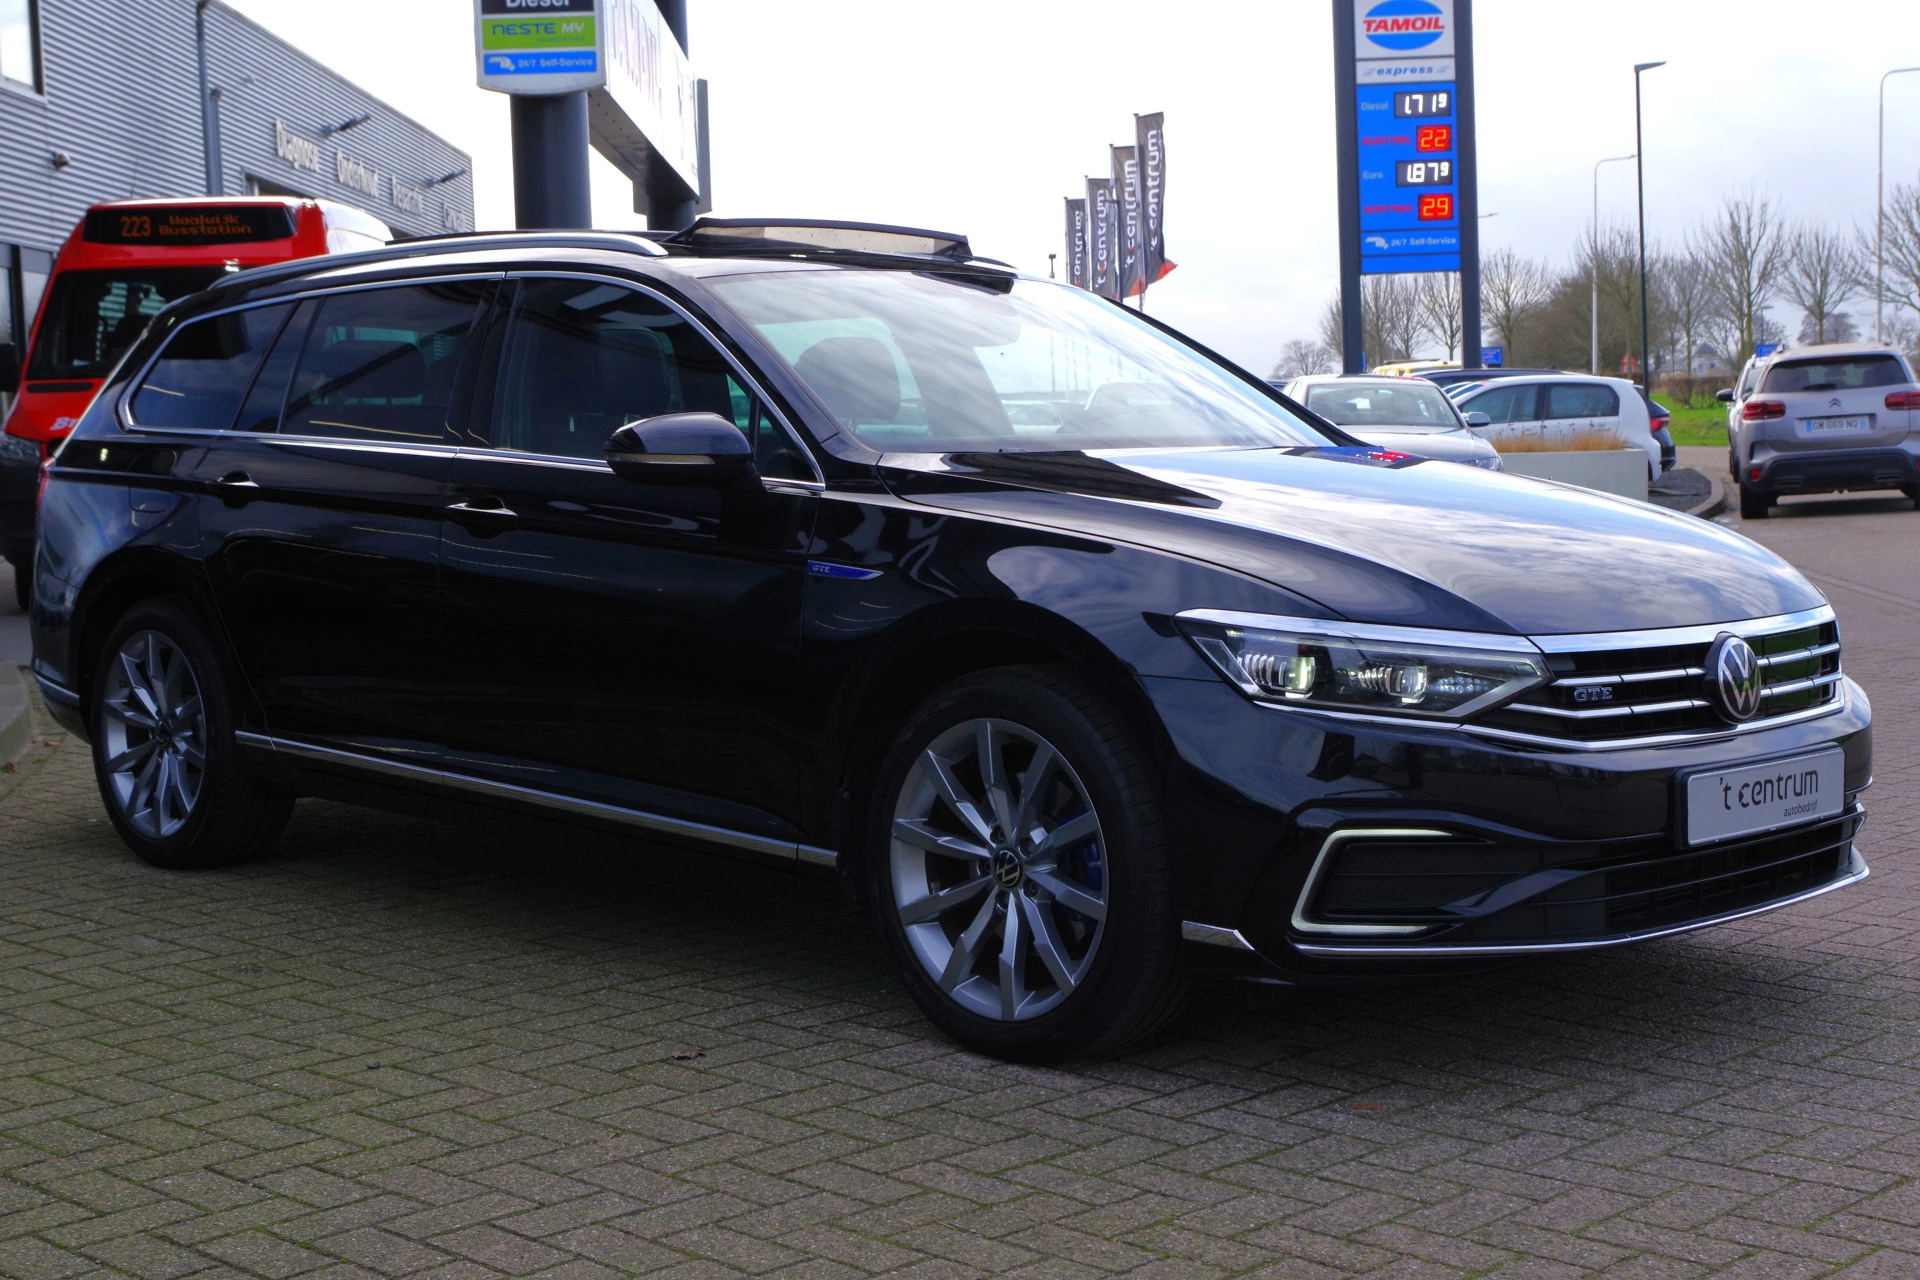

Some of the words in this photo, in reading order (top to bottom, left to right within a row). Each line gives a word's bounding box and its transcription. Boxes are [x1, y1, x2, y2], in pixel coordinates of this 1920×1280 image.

[492, 22, 557, 36] NESTE
[562, 22, 585, 34] MY
[1363, 17, 1445, 33] TAMOIL
[518, 60, 537, 68] 24/7
[540, 58, 593, 67] Self-Service
[1377, 66, 1434, 77] express
[1361, 101, 1389, 111] Diesel
[1362, 135, 1411, 145] KORTING
[1421, 129, 1447, 148] 22
[1147, 129, 1160, 233] centrum
[1363, 171, 1384, 180] Euro
[1124, 159, 1136, 251] centrum
[1363, 203, 1413, 213] KORTING
[1423, 197, 1449, 216] 29
[121, 216, 151, 237] 223
[159, 224, 252, 235] Busstation
[1097, 189, 1107, 273] centrum
[1391, 239, 1407, 247] 24/7
[1410, 237, 1457, 246] Self-Service
[812, 564, 831, 573] GTE
[1573, 686, 1614, 703] GTE
[1719, 777, 1732, 811] 't
[1738, 769, 1819, 809] centrum
[1783, 799, 1819, 817] autobedrijf
